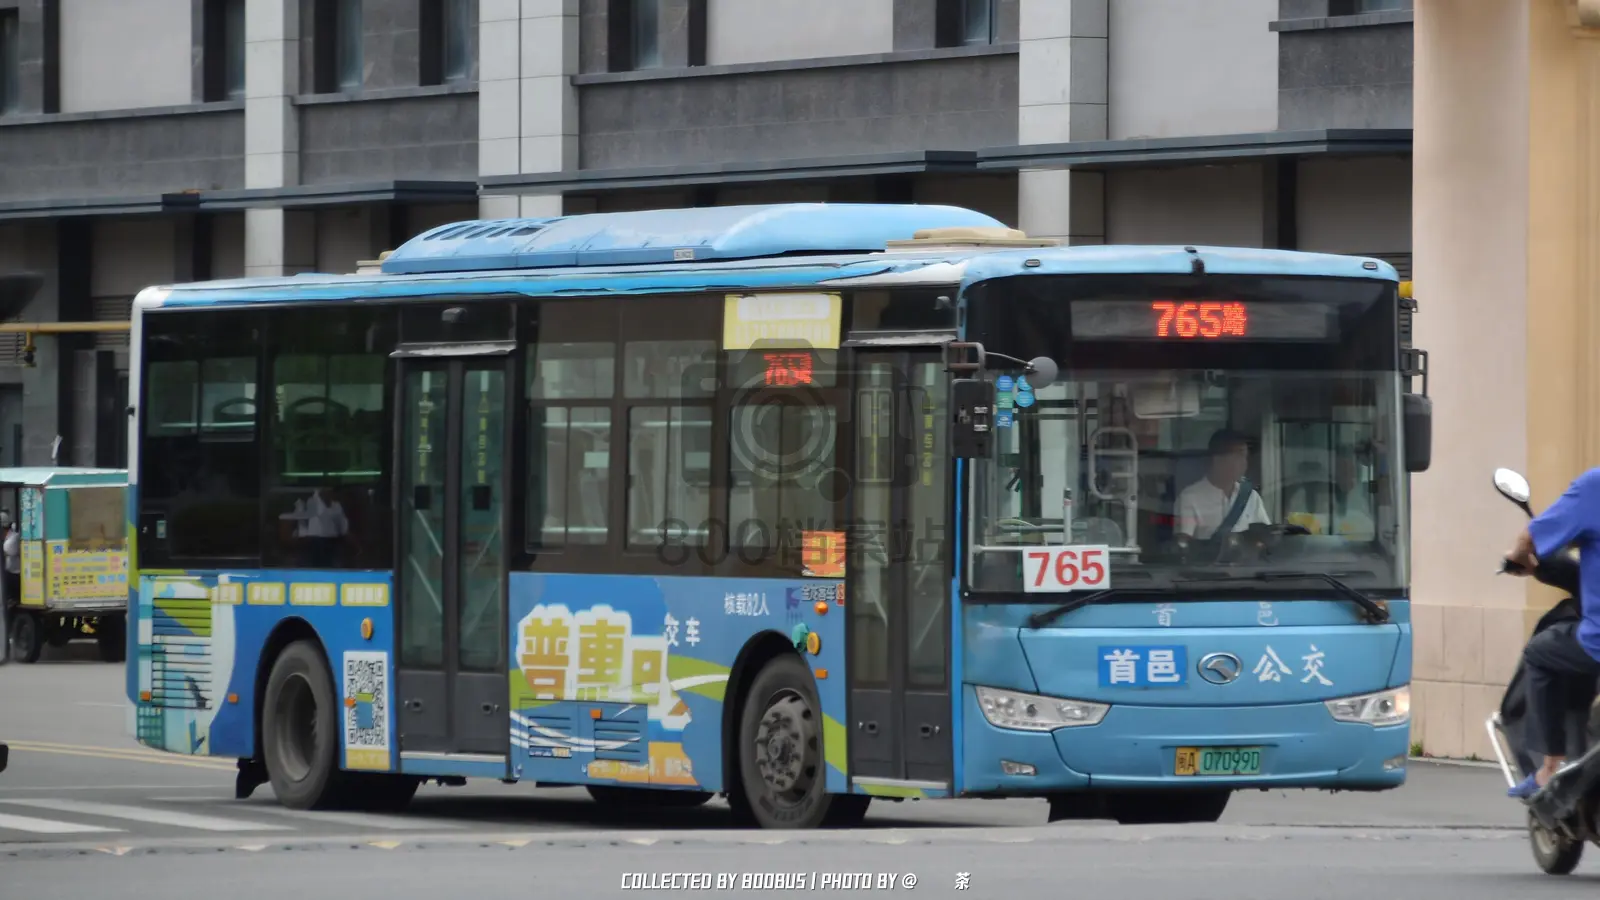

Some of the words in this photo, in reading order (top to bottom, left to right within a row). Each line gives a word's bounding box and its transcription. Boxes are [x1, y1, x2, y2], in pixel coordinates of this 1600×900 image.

[1152, 303, 1247, 337] 765路
[1027, 549, 1105, 588] 765
[1103, 650, 1181, 684] 首邑
[1252, 644, 1334, 686] 公交
